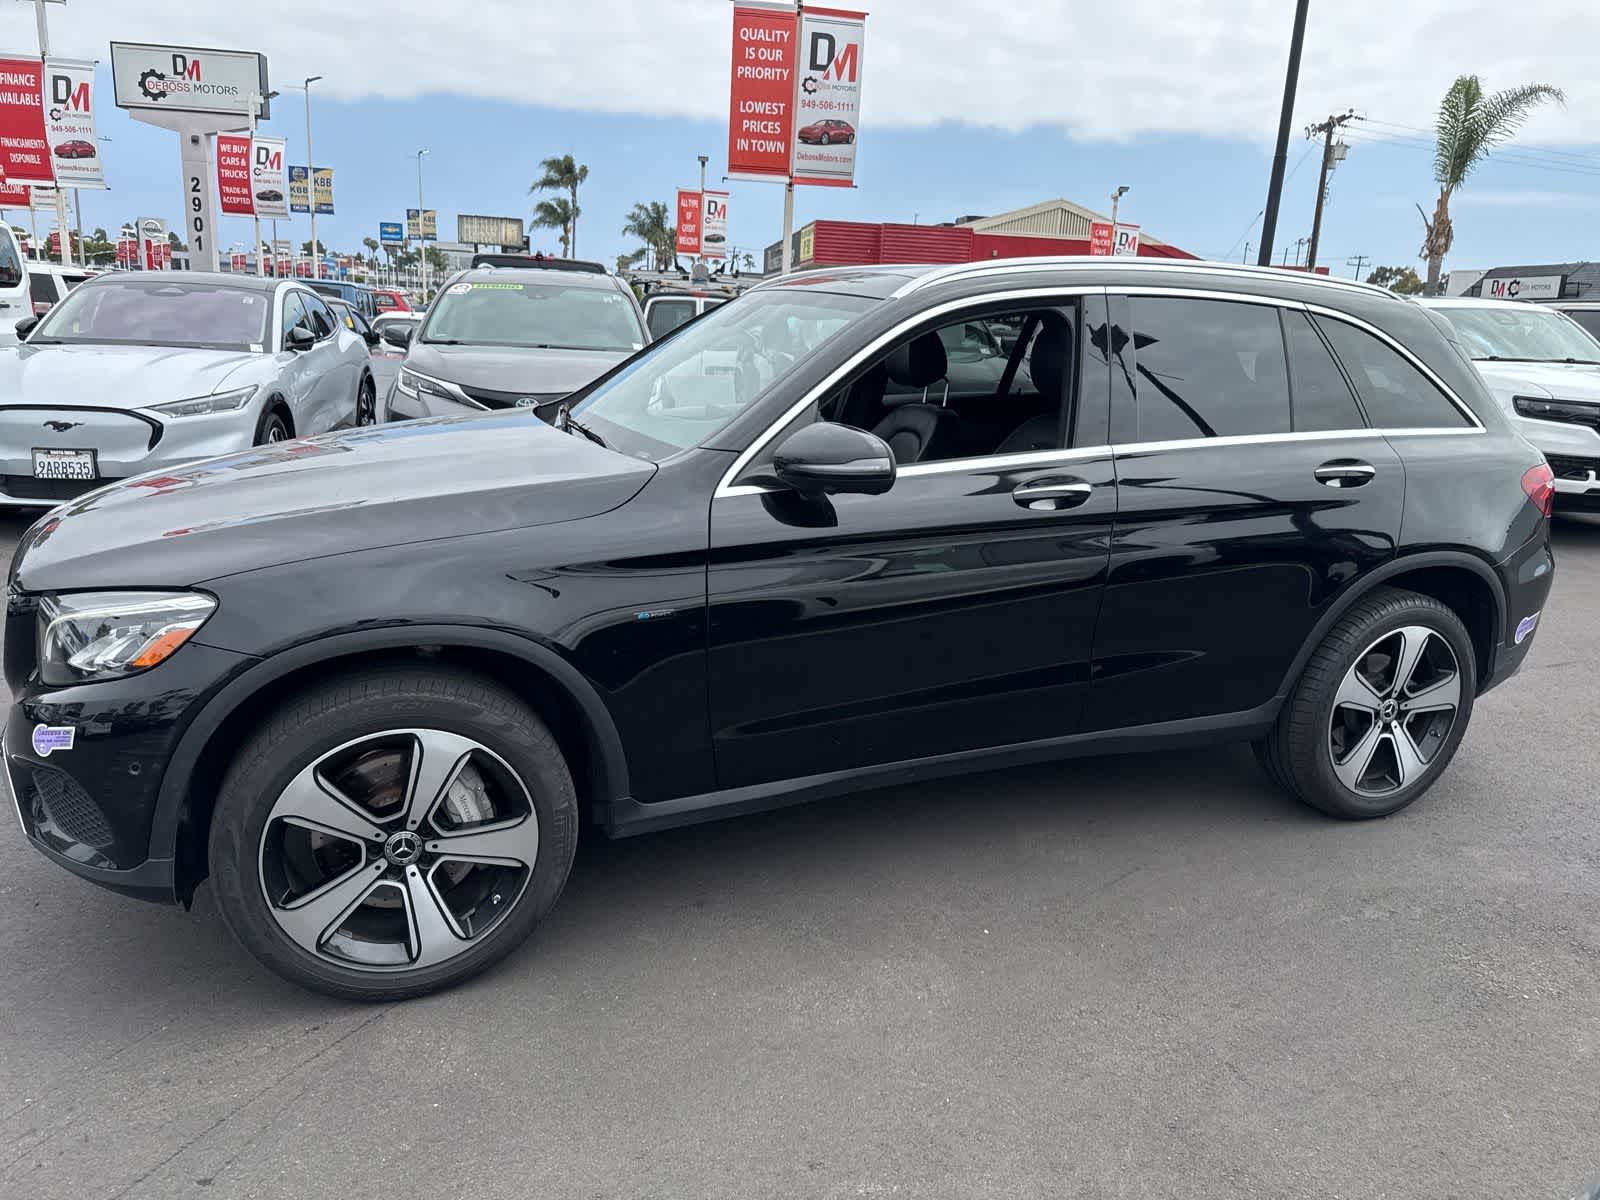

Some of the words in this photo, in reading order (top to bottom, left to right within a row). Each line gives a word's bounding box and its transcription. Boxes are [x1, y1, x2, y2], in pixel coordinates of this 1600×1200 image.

[740, 27, 790, 43] QUALITY
[745, 47, 756, 60] IS
[758, 48, 783, 62] OUR
[0, 72, 36, 87] FINANCE
[737, 66, 790, 81] PRIORITY
[147, 80, 191, 93] DEBOSS
[193, 84, 239, 96] MOTORS
[740, 101, 786, 116] LOWEST
[801, 99, 855, 112] 949-506-1111
[51, 125, 92, 135] 949-506-1111
[743, 120, 781, 135] PRICES
[220, 144, 232, 153] WE
[233, 145, 248, 154] BUY
[737, 139, 749, 152] IN
[751, 140, 785, 154] TOWN
[10, 153, 41, 165] DISPONIBLE
[221, 157, 240, 166] CARS
[221, 169, 249, 179] TRUCKS
[0, 183, 25, 195] ELCOME
[222, 186, 249, 195] TRADE-IN
[223, 196, 251, 205] ACCEPTED
[38, 461, 91, 477] 9ARB535
